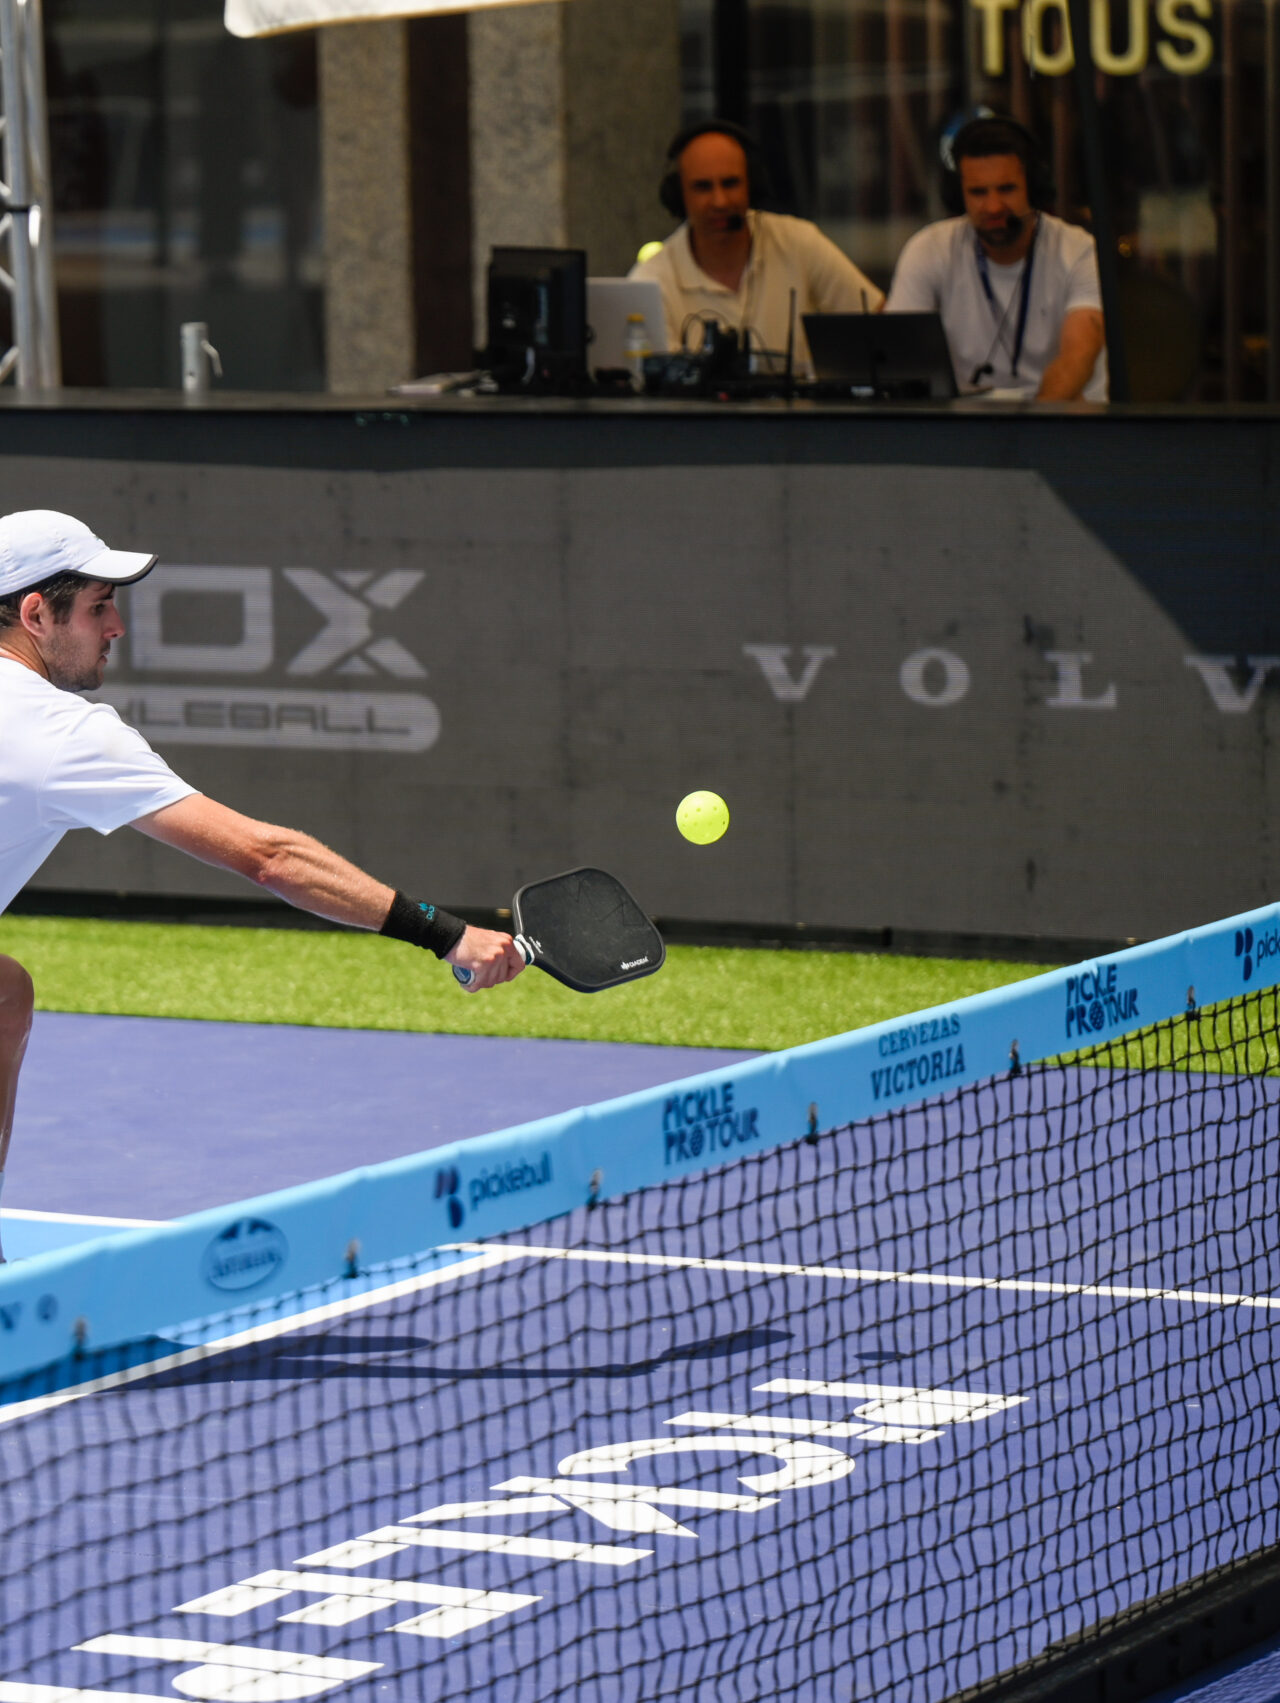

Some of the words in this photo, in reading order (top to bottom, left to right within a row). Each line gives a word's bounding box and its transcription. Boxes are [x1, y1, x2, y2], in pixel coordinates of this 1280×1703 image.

[974, 0, 1214, 76] TOUS
[109, 565, 429, 679] OX
[878, 1012, 961, 1057] CERVEZAS
[871, 1043, 966, 1100] VICTORIA
